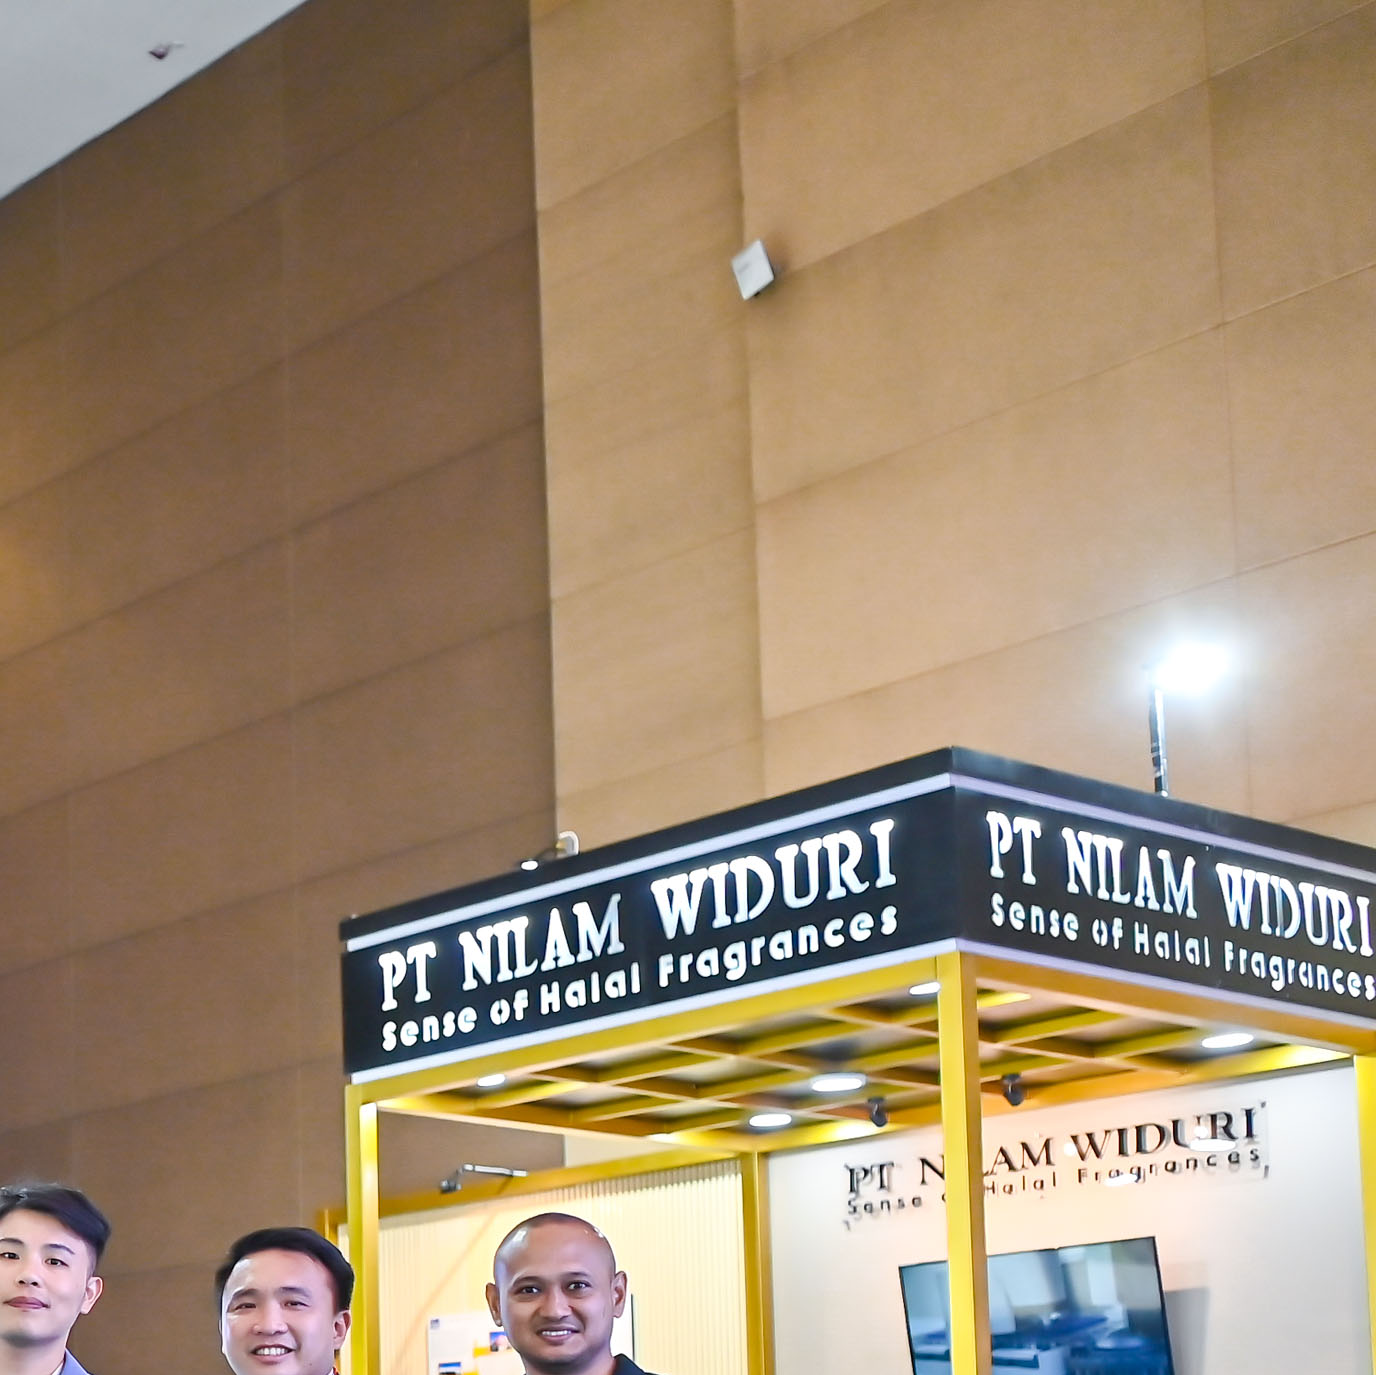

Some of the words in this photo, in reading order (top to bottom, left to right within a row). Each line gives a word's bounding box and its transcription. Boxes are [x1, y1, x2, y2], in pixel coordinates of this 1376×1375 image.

[378, 941, 437, 1011] PT
[459, 893, 625, 992] NILAM
[650, 818, 895, 940] WIDURI
[985, 810, 1041, 886] PT
[1061, 826, 1198, 919] NILAM
[1215, 861, 1375, 957] WIDURI
[991, 892, 1079, 941] Sense
[1092, 917, 1123, 950] of
[1134, 921, 1210, 968] Halal
[1224, 940, 1376, 1001] Fragrances
[382, 1007, 477, 1052] Sense
[490, 989, 529, 1025] of
[540, 962, 641, 1016] Halal
[658, 905, 897, 988] Fragrances
[846, 1162, 894, 1194] PT
[920, 1137, 1056, 1187] NAM
[1071, 1106, 1257, 1161] WIDURI
[847, 1195, 922, 1216] Sense
[984, 1170, 1057, 1195] Halal
[1077, 1147, 1260, 1184] Fragrances
